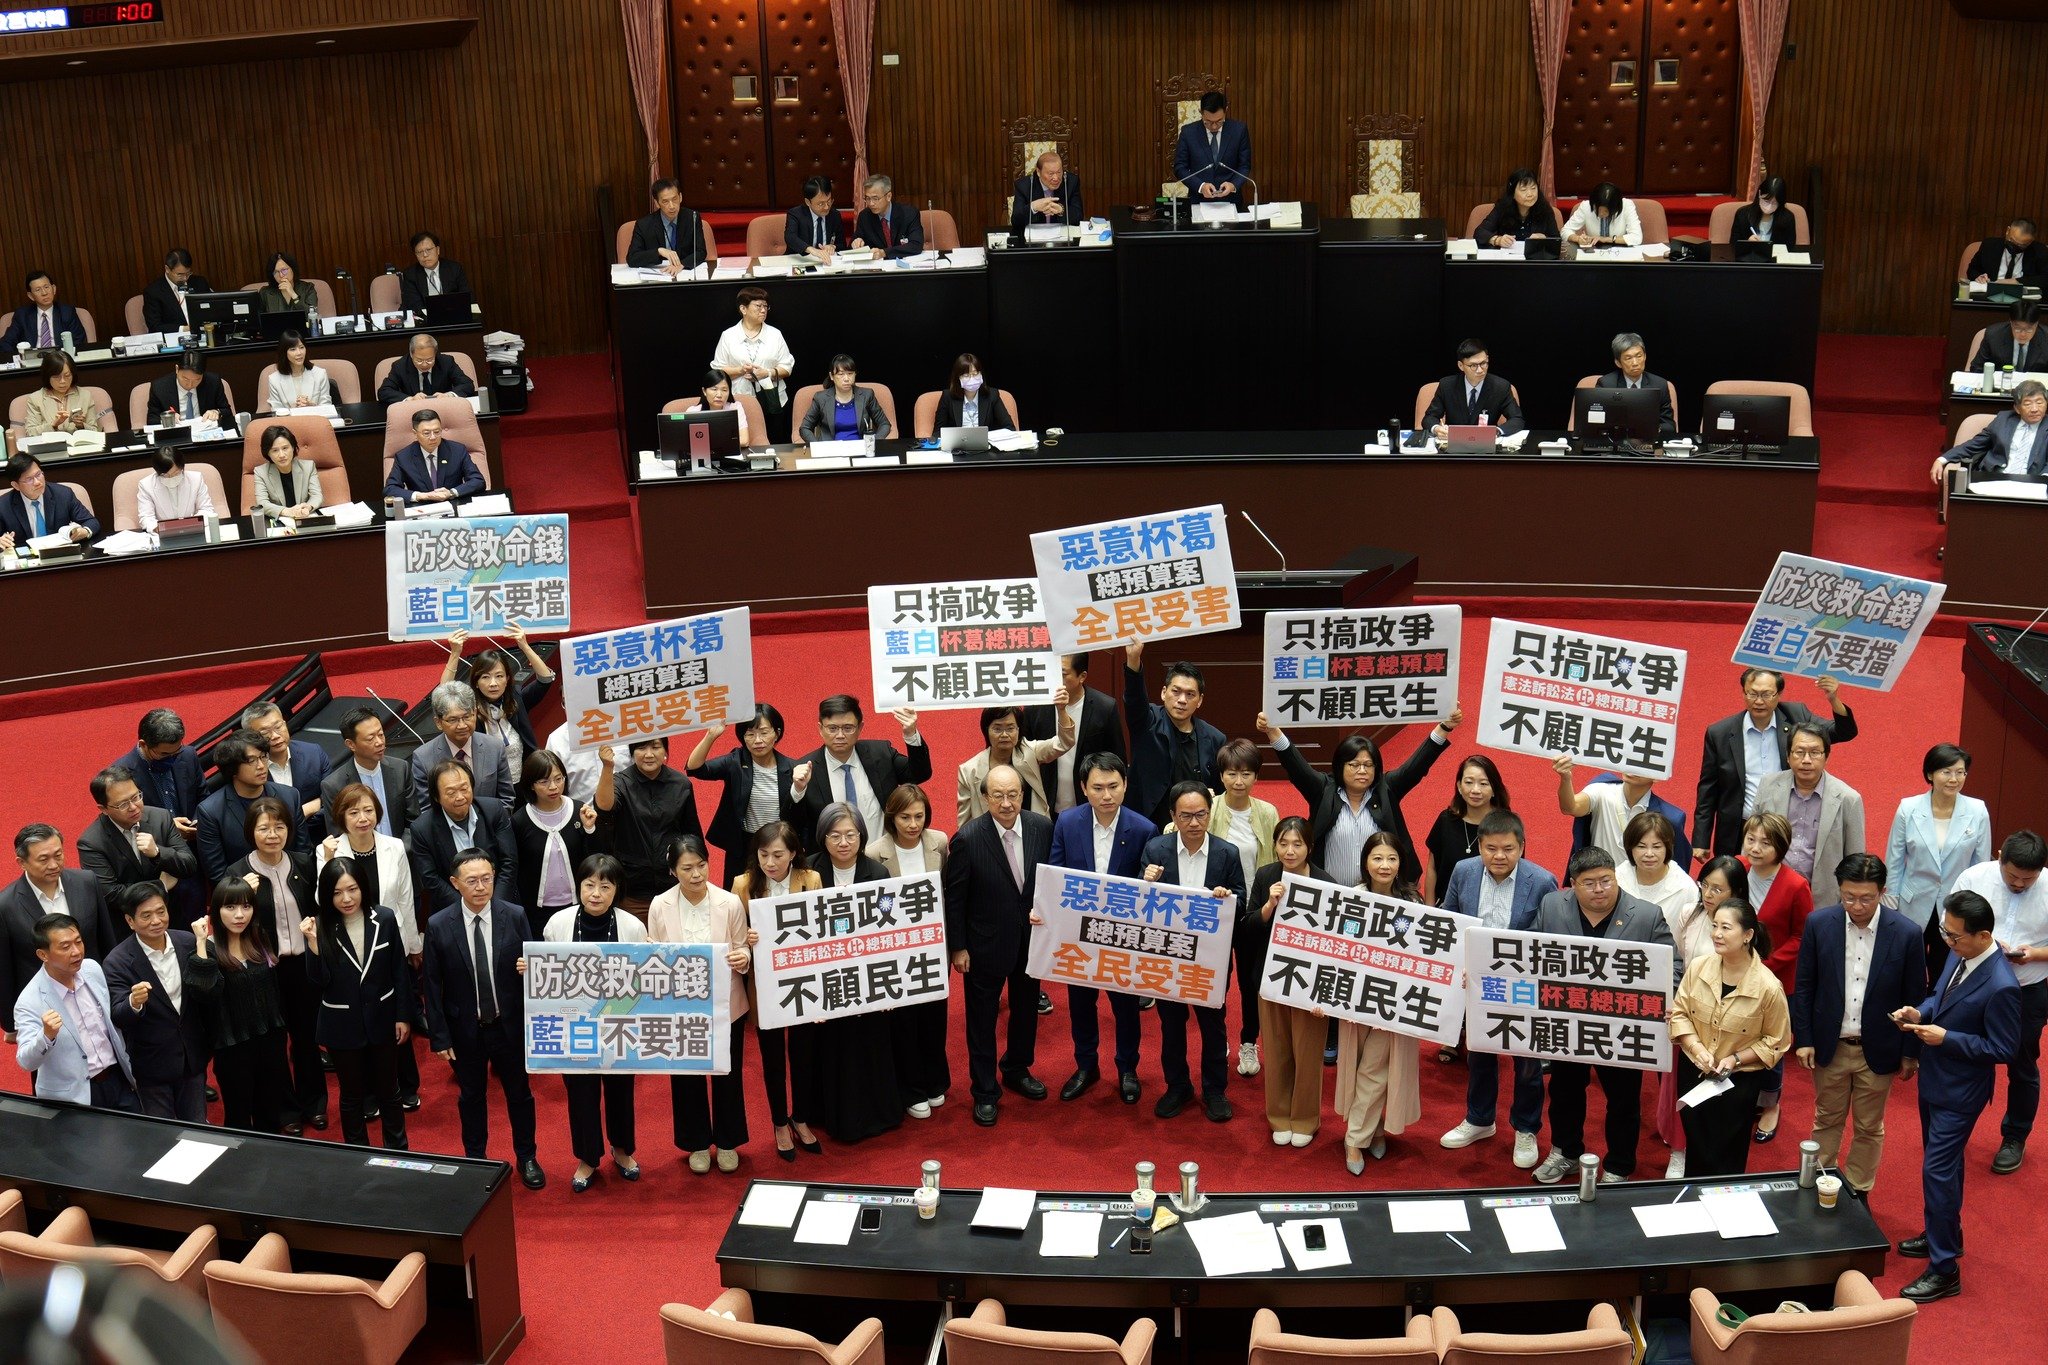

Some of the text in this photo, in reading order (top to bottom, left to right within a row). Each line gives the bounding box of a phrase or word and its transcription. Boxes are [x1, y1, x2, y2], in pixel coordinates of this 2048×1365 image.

[405, 524, 566, 573] 防災救命錢
[1058, 512, 1215, 572] 惡意杯葛
[408, 580, 565, 624] 藍白不要擋
[892, 583, 1038, 624] 只搞政爭
[1095, 559, 1201, 599] 總預算案
[1764, 565, 1923, 630] 防災救命錢
[1071, 586, 1231, 646] 全民受害
[1282, 613, 1435, 651] 只搞政爭
[572, 616, 724, 677] 惡意杯葛
[1507, 630, 1678, 695] 只搞政爭
[1743, 617, 1898, 677] 藍白不要擋
[604, 660, 706, 701] 總預算案
[892, 658, 1049, 701] 不顧民生
[1277, 682, 1438, 722] 不顧民生
[576, 685, 730, 746] 全民受害
[1500, 702, 1668, 772] 不顧民生
[774, 879, 938, 945] 只搞政爭
[1060, 874, 1223, 933] 惡意杯葛
[1280, 882, 1457, 955] 只搞政爭
[1086, 918, 1195, 960] 總預算案
[1489, 937, 1650, 984] 只搞政爭
[528, 953, 711, 1000] 防災救命錢
[778, 952, 945, 1017] 不顧民生
[1052, 943, 1216, 1001] 全民受害
[1269, 953, 1442, 1032] 不顧民生
[530, 1015, 709, 1057] 藍白不要擋
[1486, 1012, 1657, 1065] 不顧民生
